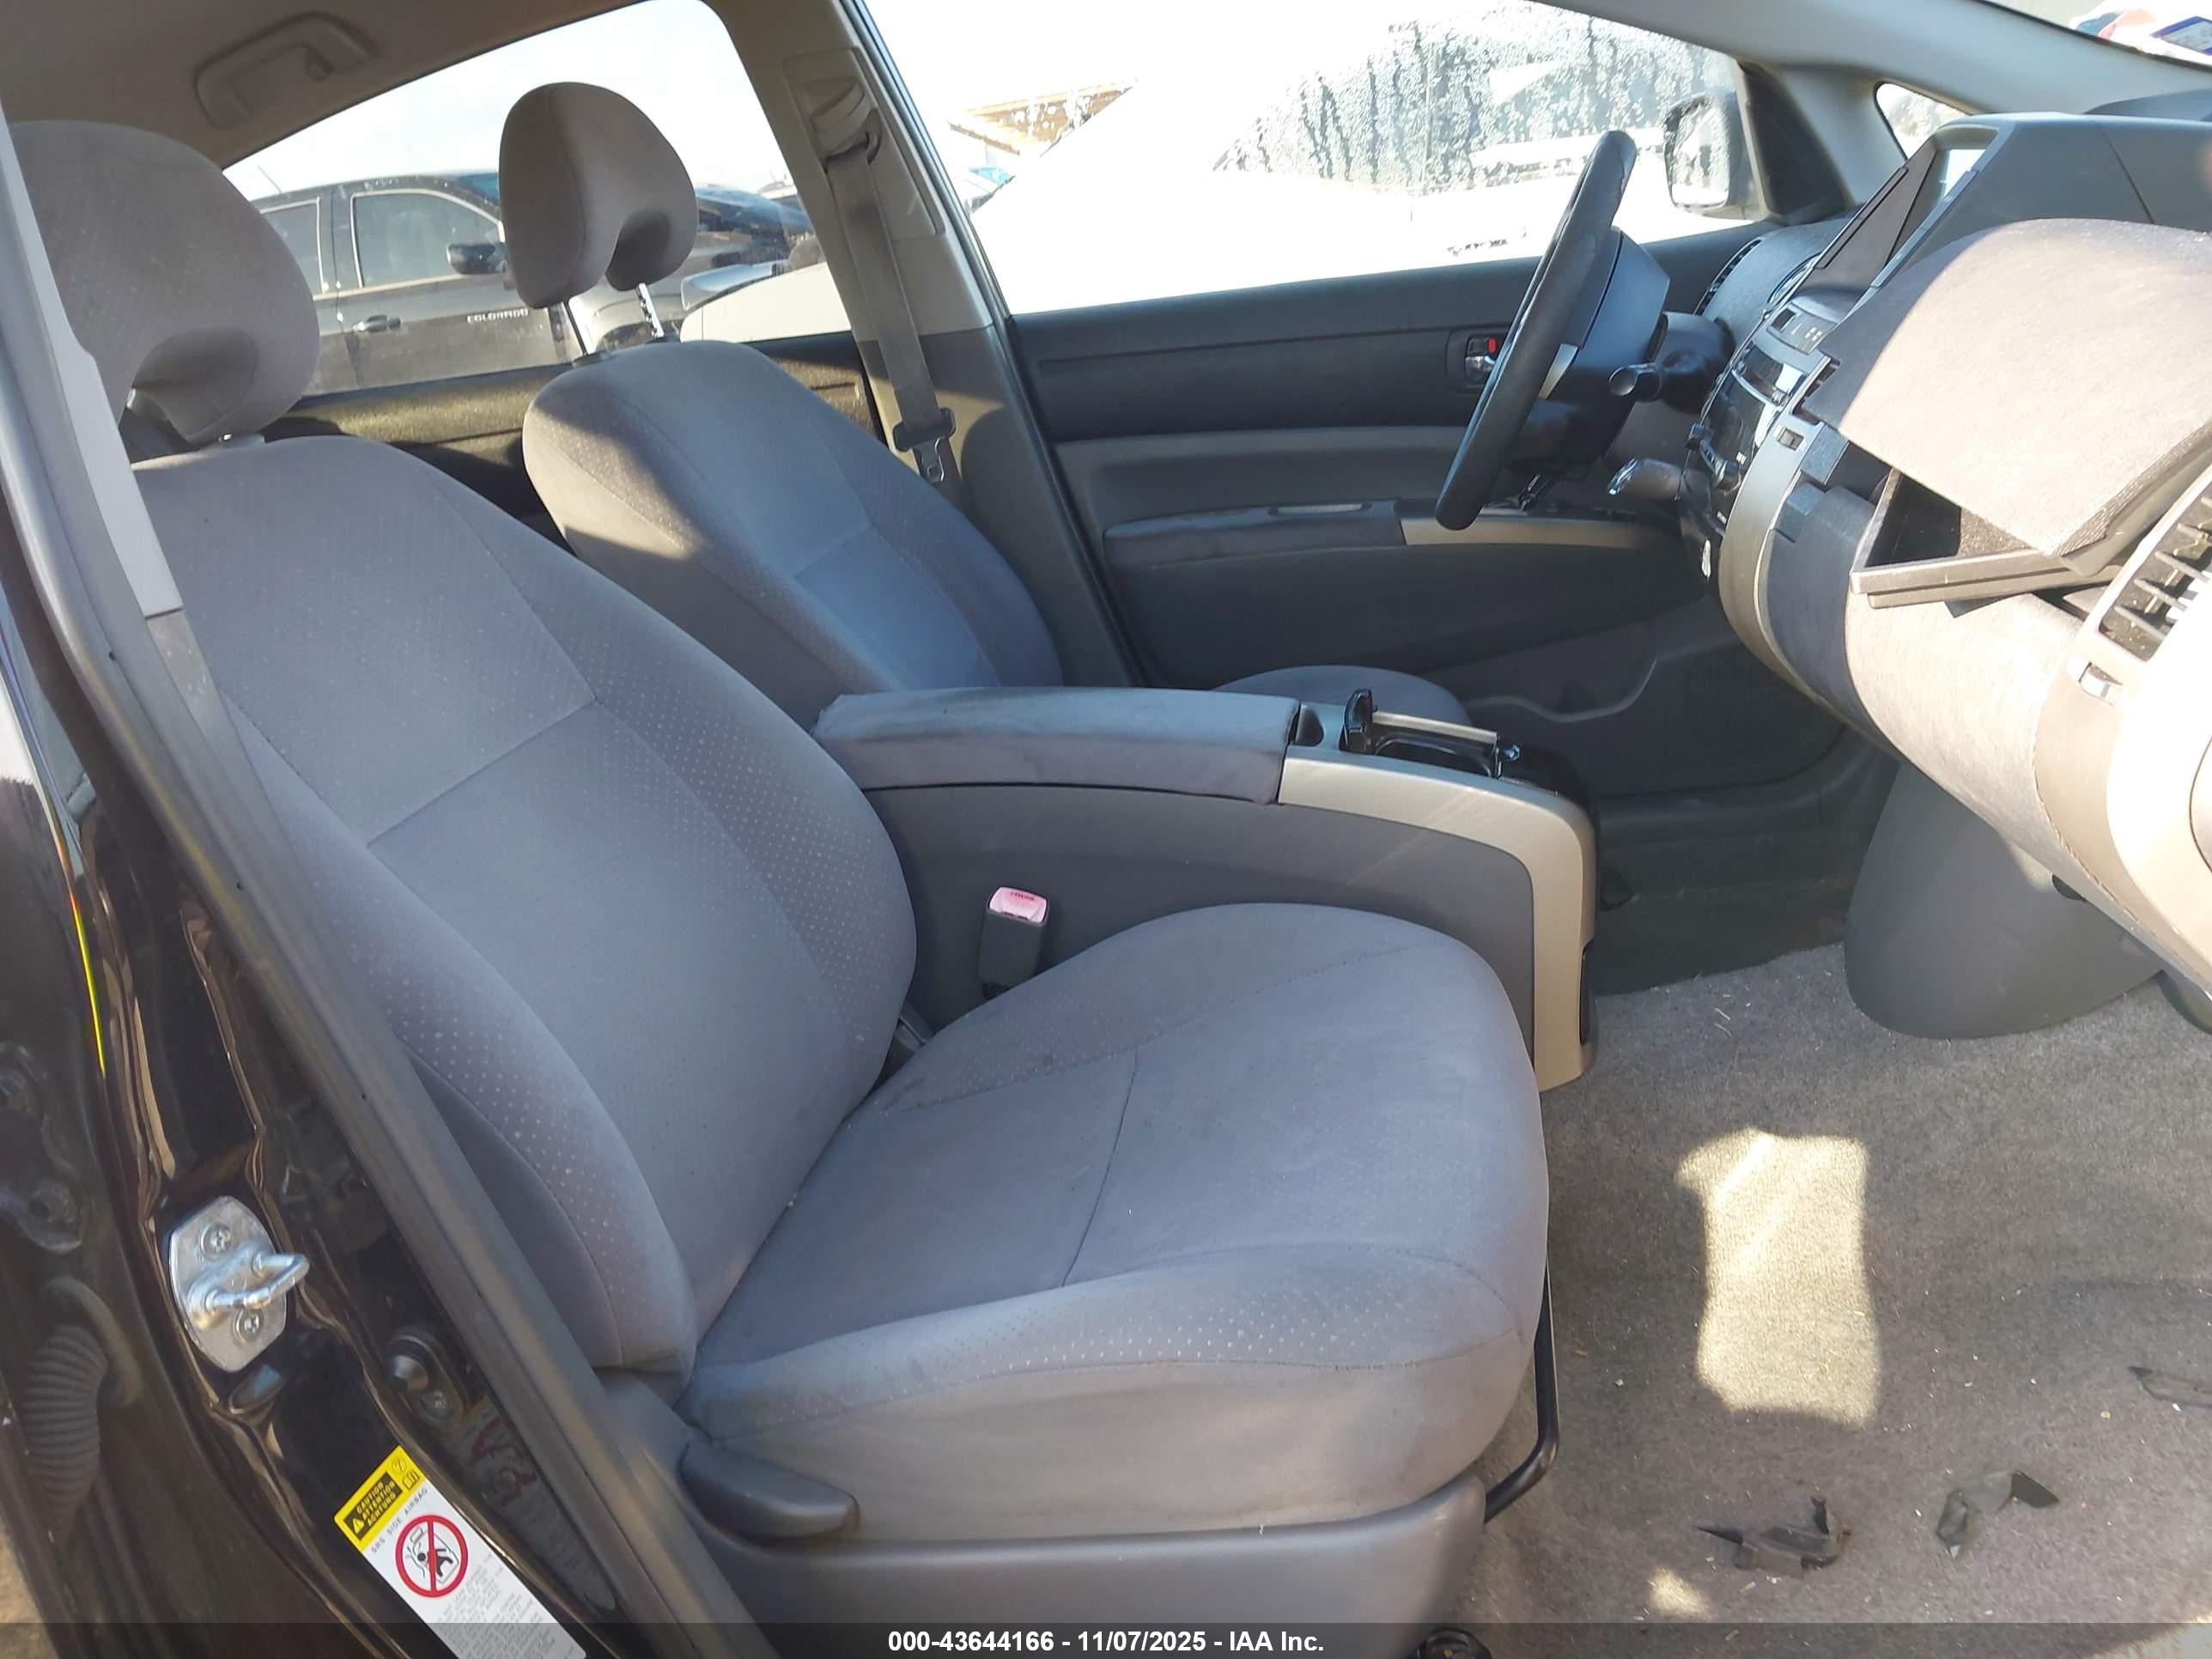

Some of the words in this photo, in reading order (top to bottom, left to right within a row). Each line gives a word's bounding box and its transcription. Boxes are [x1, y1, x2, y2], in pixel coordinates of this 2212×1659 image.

[467, 307, 529, 324] COLORADO
[356, 1480, 384, 1514] CAUTION
[361, 1481, 396, 1520] ATTENTION
[368, 1492, 397, 1527] ACHTUNG
[386, 1517, 403, 1536] SIDE
[404, 1488, 428, 1516] AIRBAG
